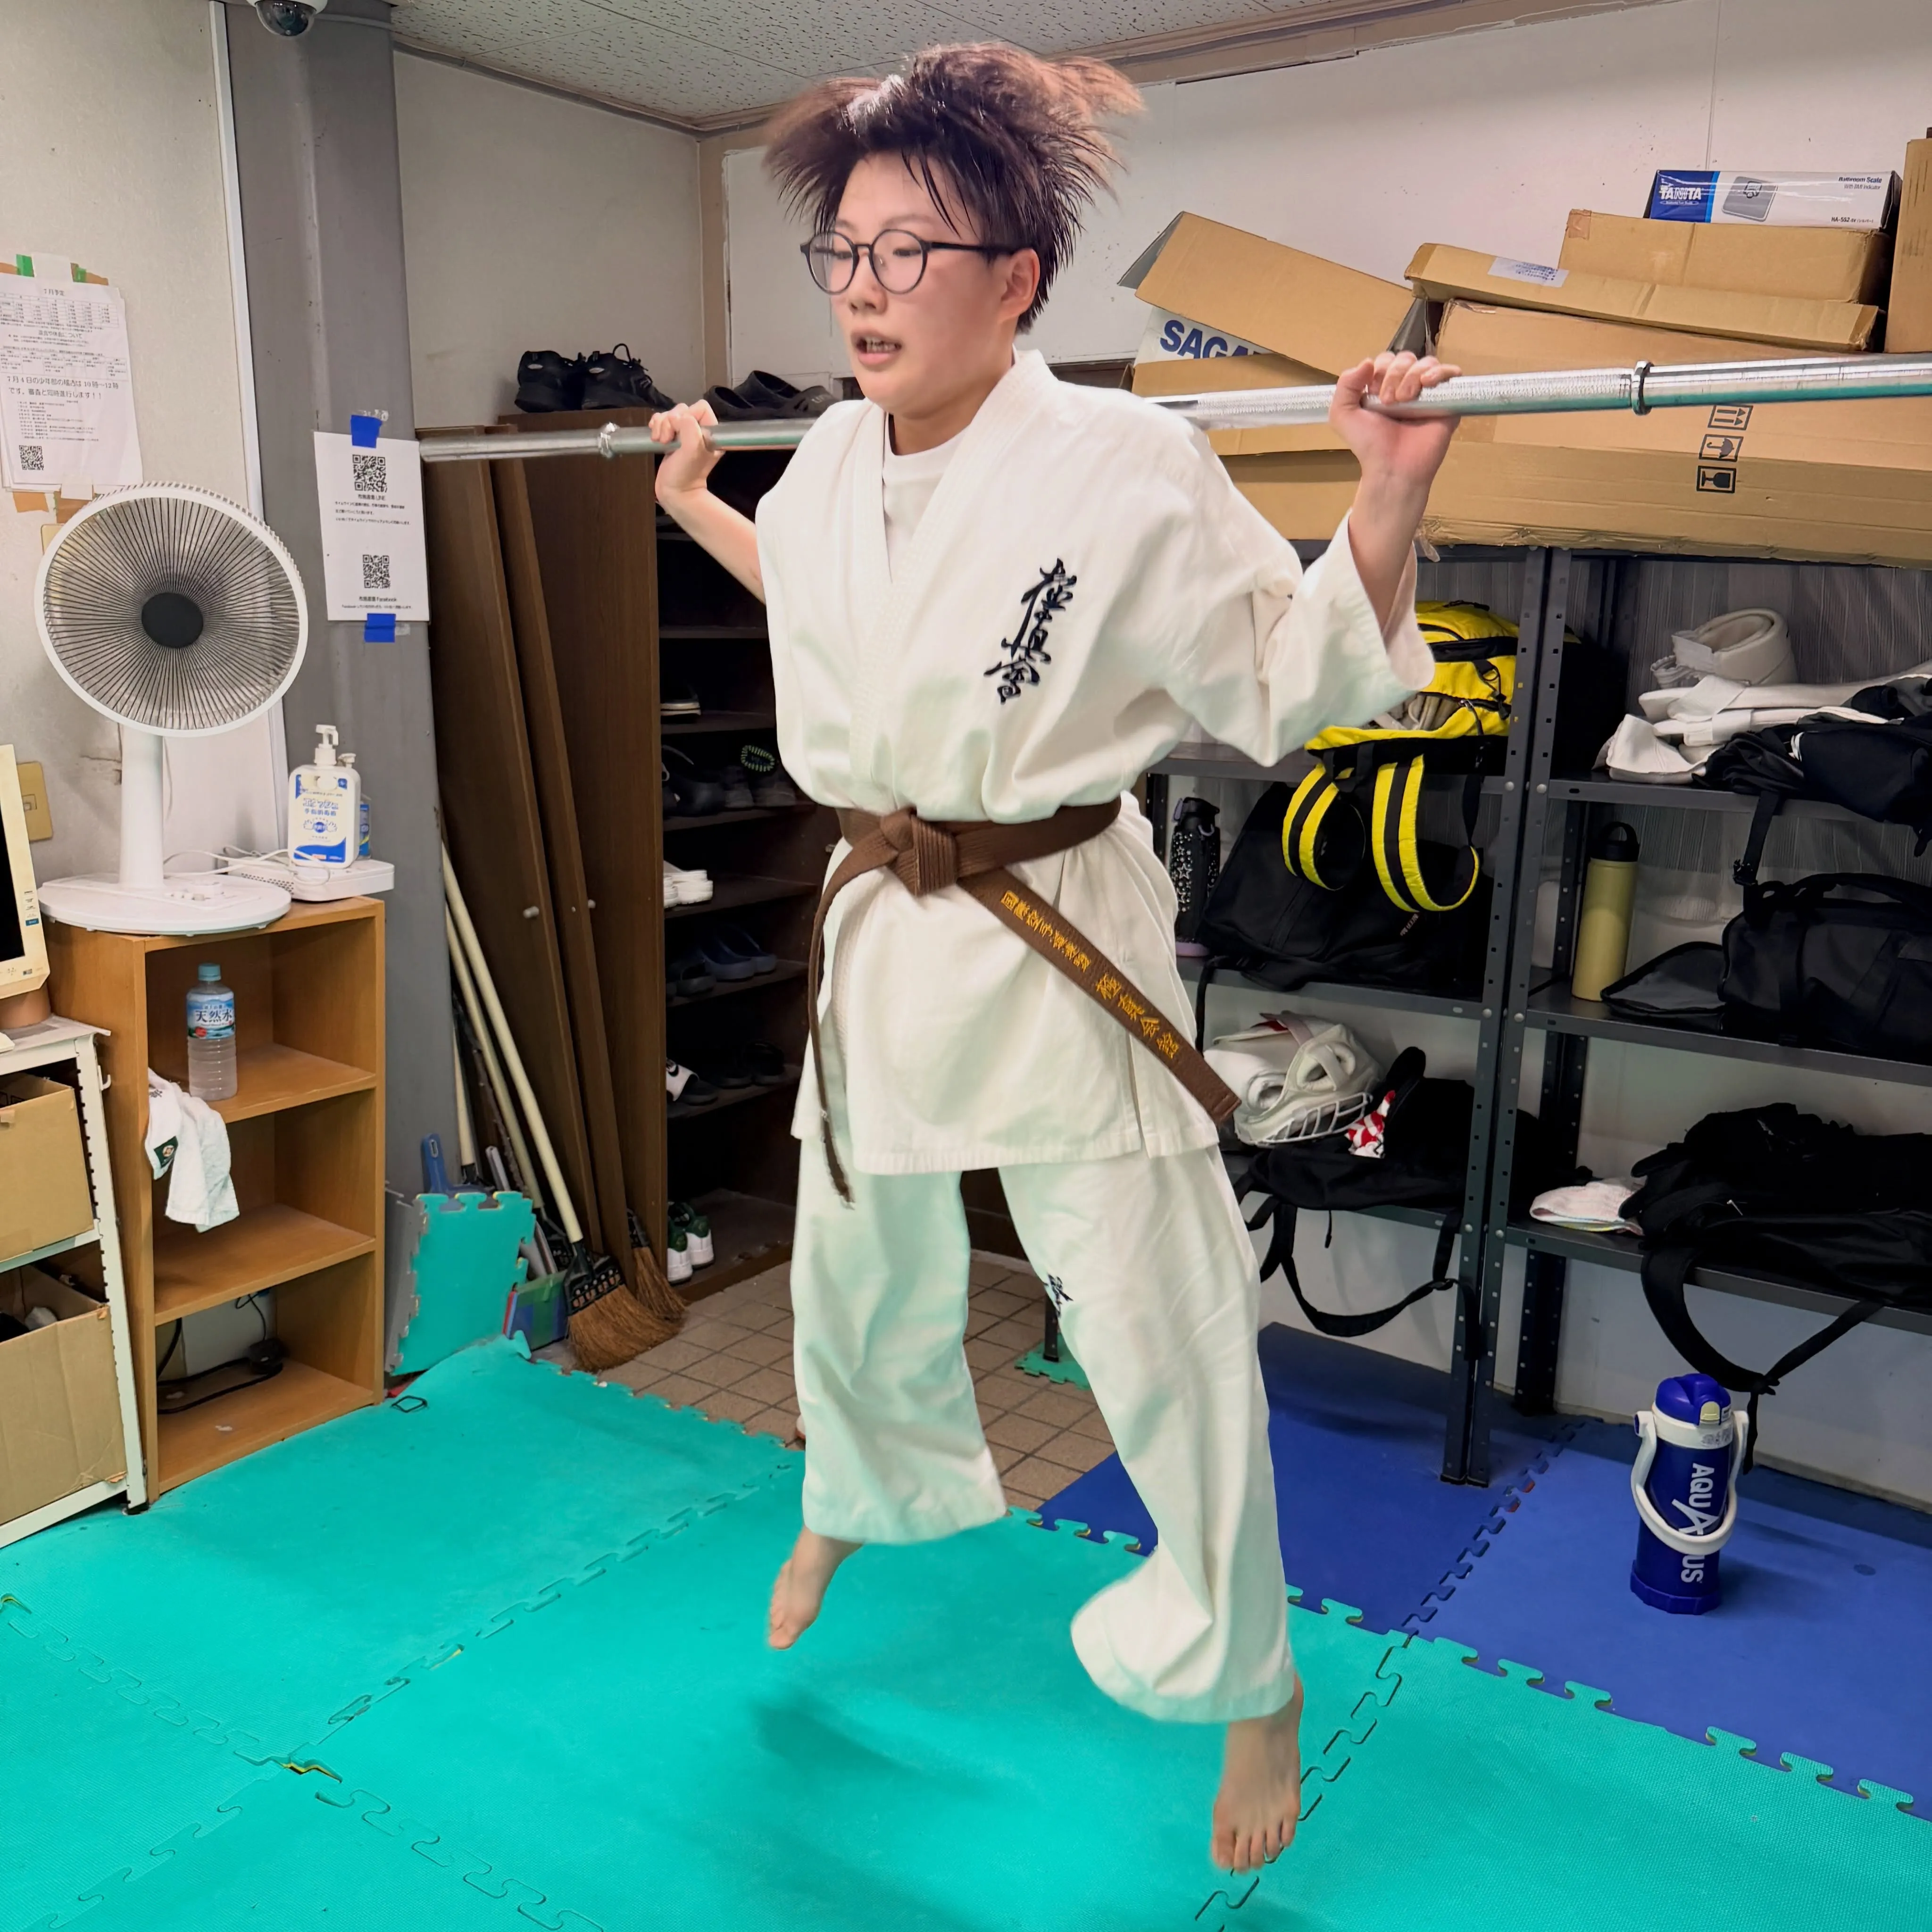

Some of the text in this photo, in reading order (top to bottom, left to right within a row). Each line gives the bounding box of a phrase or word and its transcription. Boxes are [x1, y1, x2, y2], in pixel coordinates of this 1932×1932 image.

[1659, 185, 1701, 200] TANITA
[195, 1008, 233, 1023] 天然水
[1672, 1463, 1719, 1583] AQUAUS
